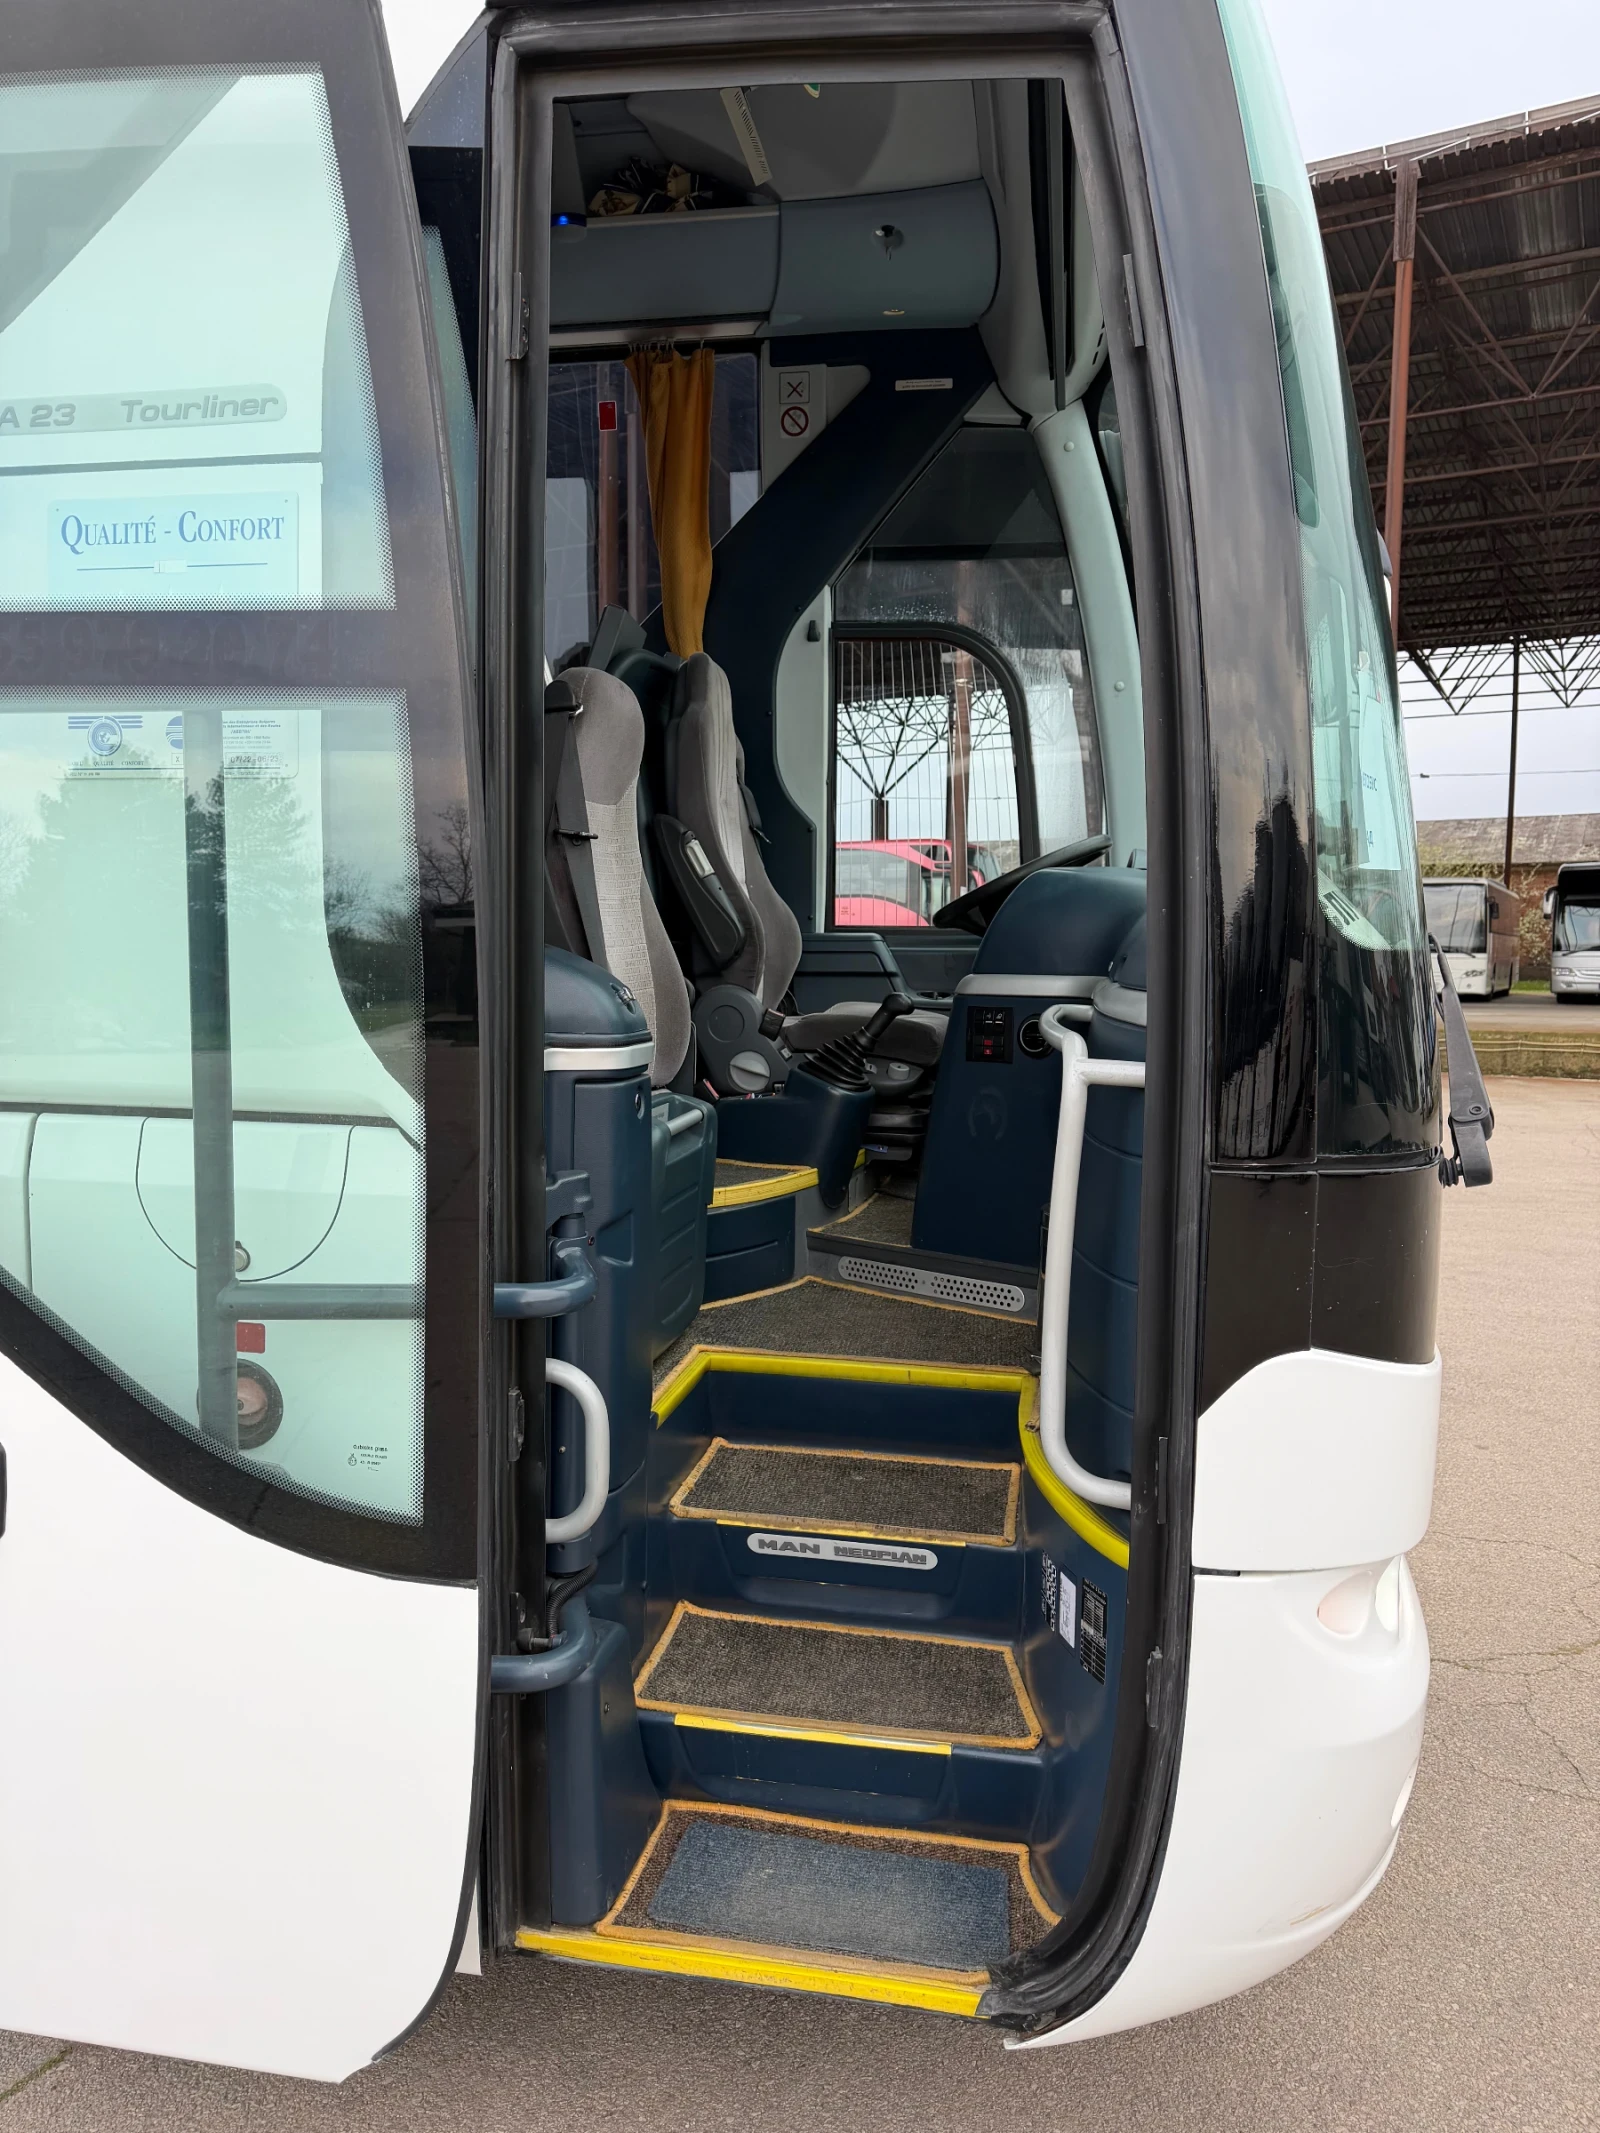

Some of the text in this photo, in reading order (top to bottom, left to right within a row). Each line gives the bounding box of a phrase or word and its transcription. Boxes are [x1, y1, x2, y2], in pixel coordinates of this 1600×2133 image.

[30, 403, 76, 428] 23
[121, 394, 279, 423] Tourliner
[61, 515, 157, 555] QUALITÉ
[178, 510, 285, 543] CONFORT
[757, 1538, 927, 1564] MAN NEOPLAN
